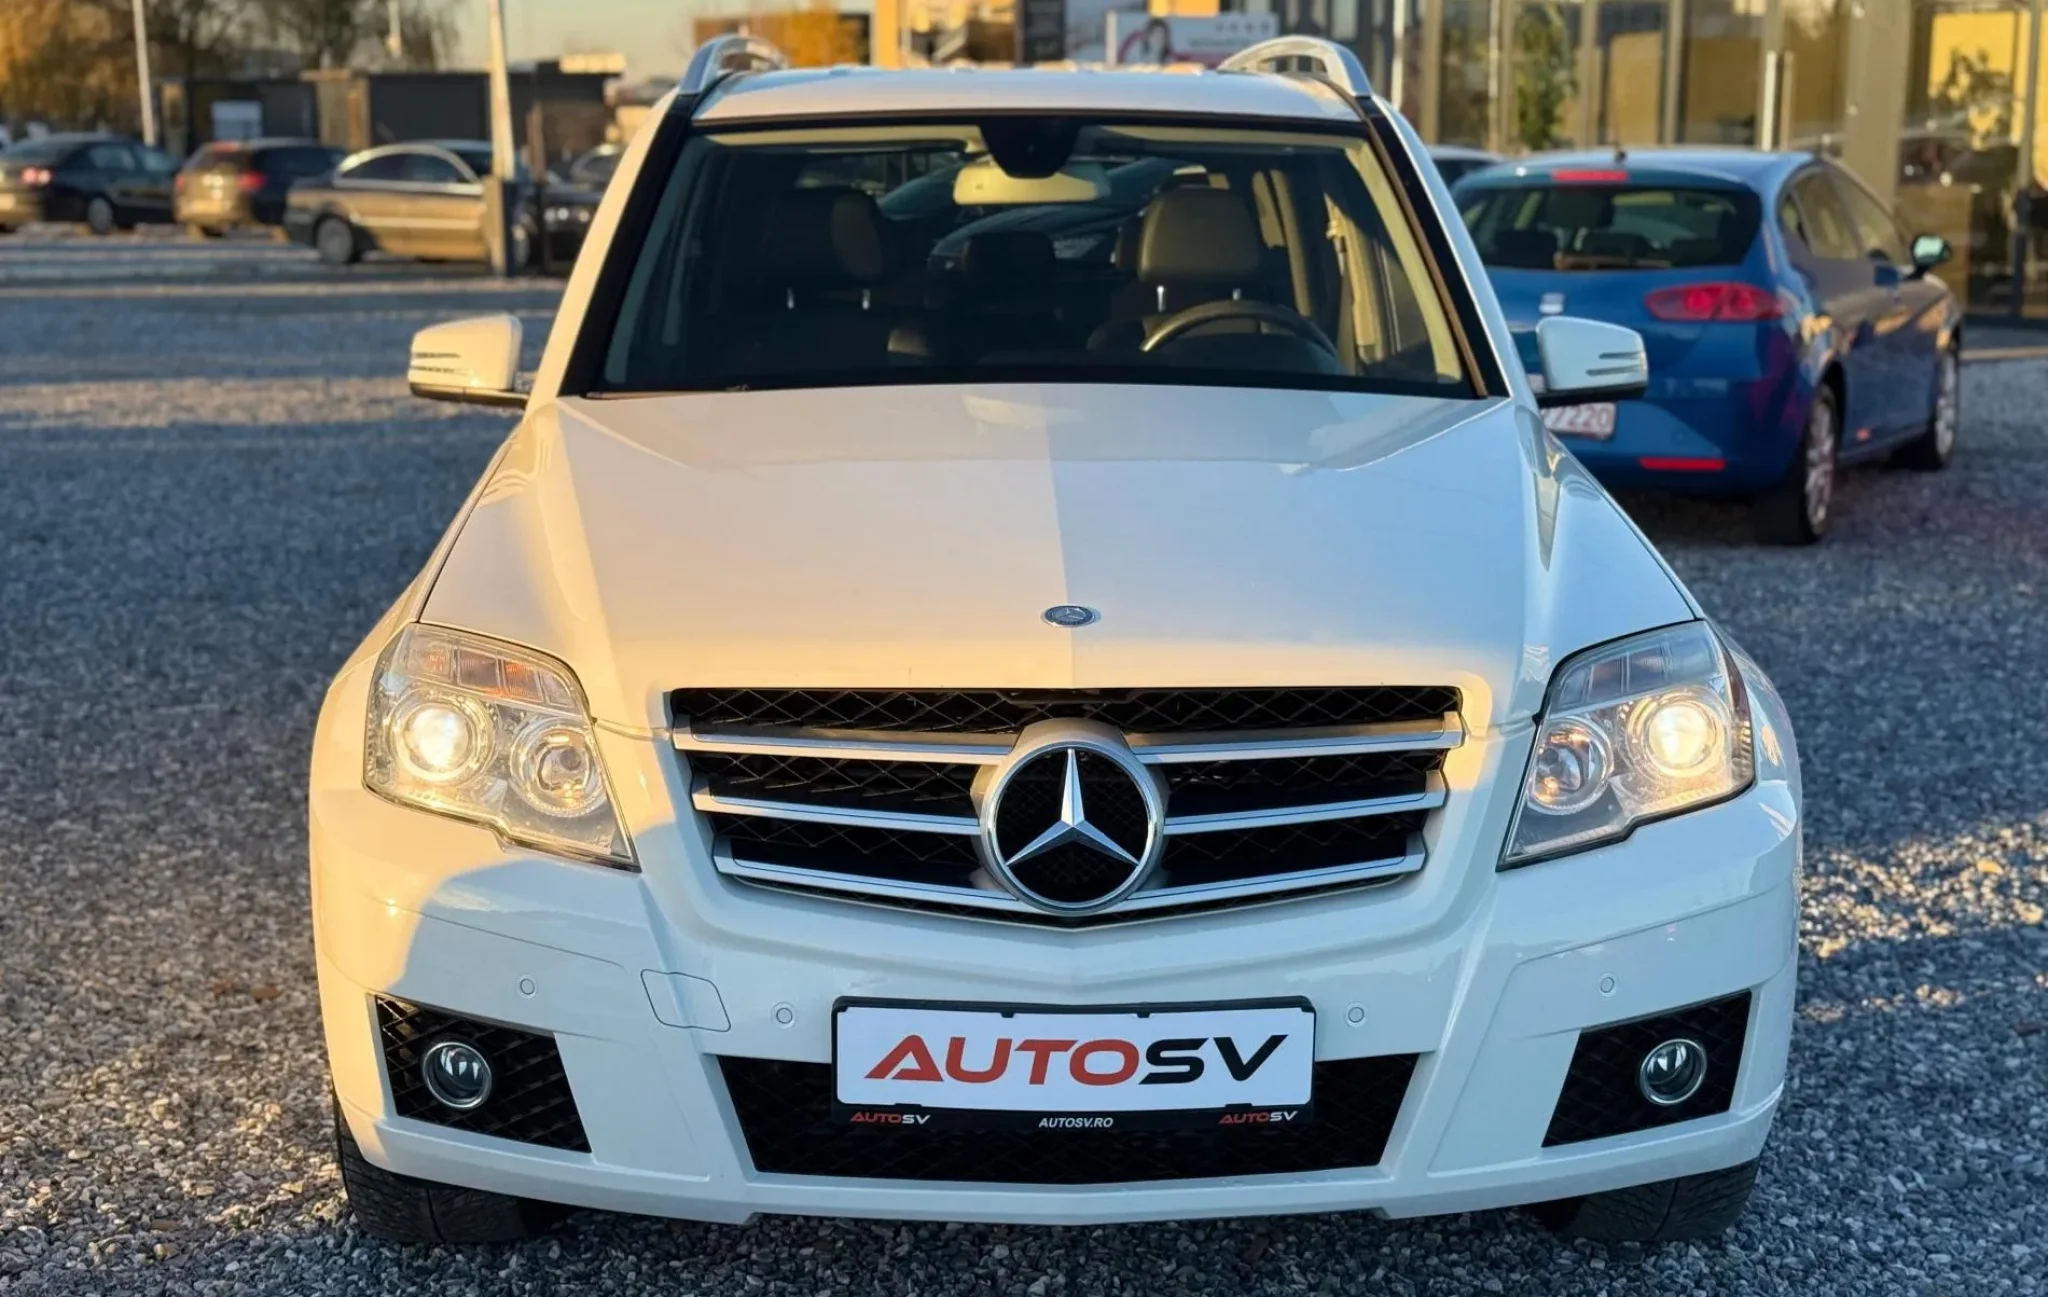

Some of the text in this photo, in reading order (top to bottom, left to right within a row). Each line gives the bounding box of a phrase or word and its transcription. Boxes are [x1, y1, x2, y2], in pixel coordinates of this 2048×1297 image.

[864, 1034, 1289, 1086] AUTOSV
[850, 1112, 931, 1125] AUTOSV
[1038, 1117, 1114, 1128] AUTOSV.RO
[1218, 1110, 1298, 1125] AUTOSV
